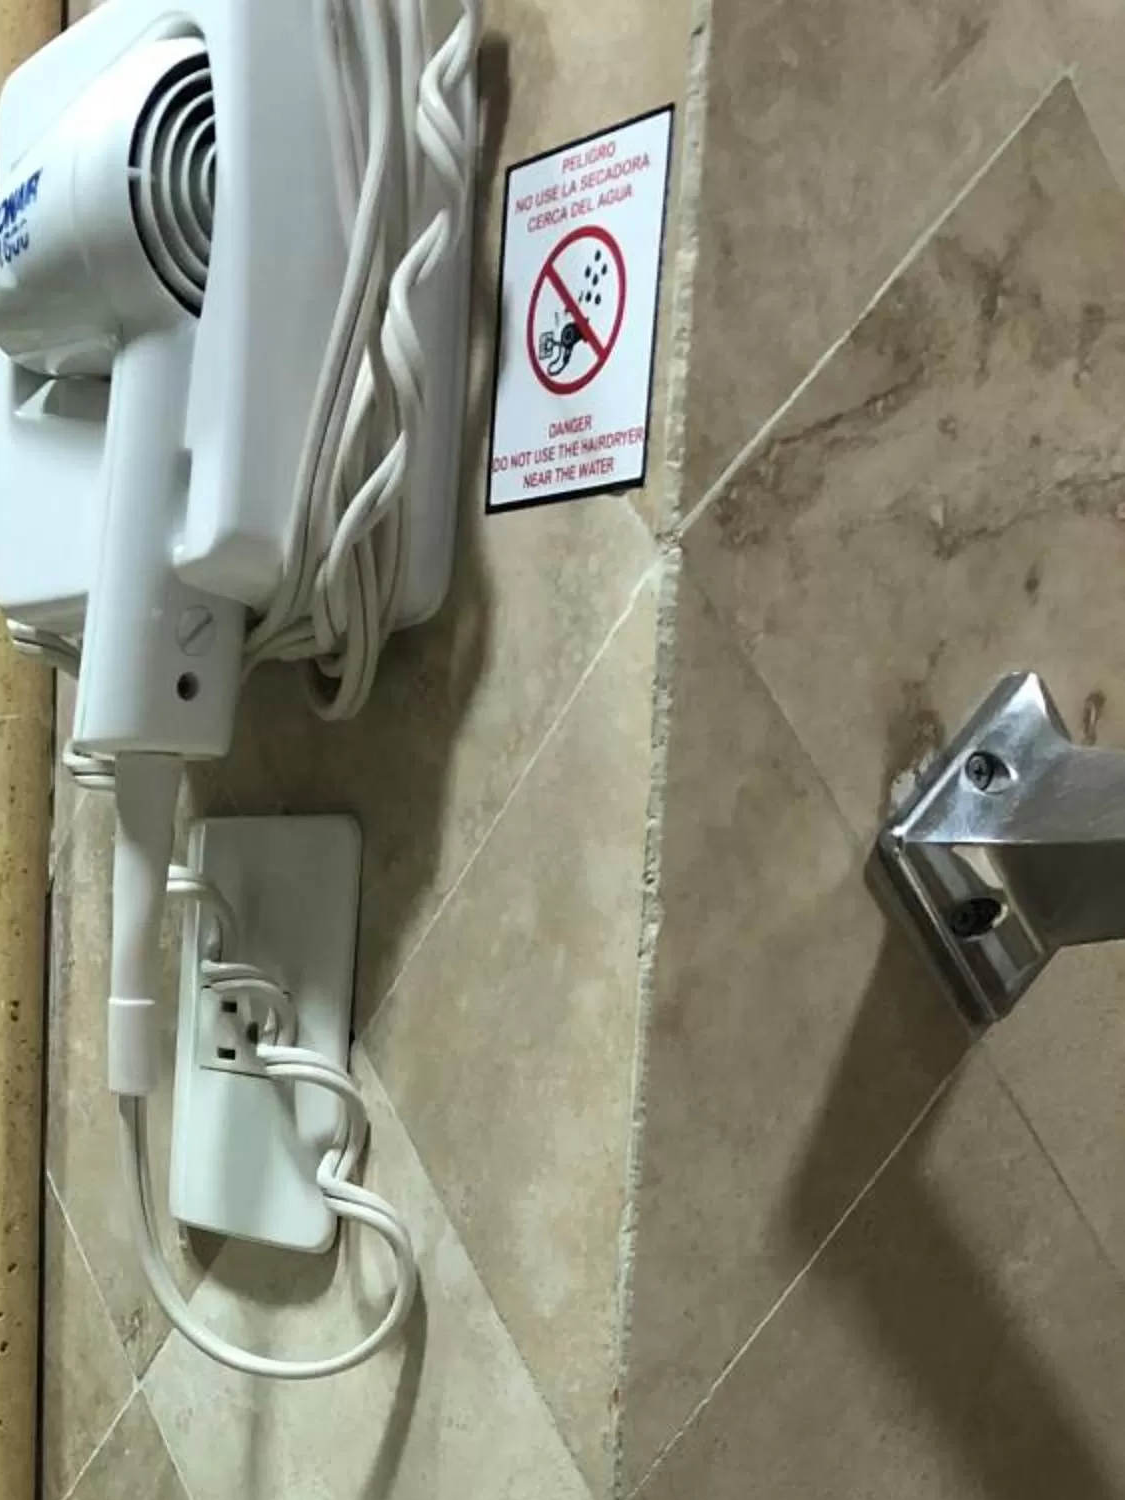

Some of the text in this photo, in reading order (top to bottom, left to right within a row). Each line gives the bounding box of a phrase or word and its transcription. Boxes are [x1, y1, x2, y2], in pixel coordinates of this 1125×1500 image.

[562, 142, 616, 174] PELIGRO
[515, 153, 650, 214] NO USE LA SECADORA
[527, 184, 633, 233] CERCA DEL AGUA
[548, 415, 592, 439] DANGER
[491, 426, 645, 473] DO NOT USE THE HAIRDRYER
[523, 457, 614, 488] NEAR THE WATER
